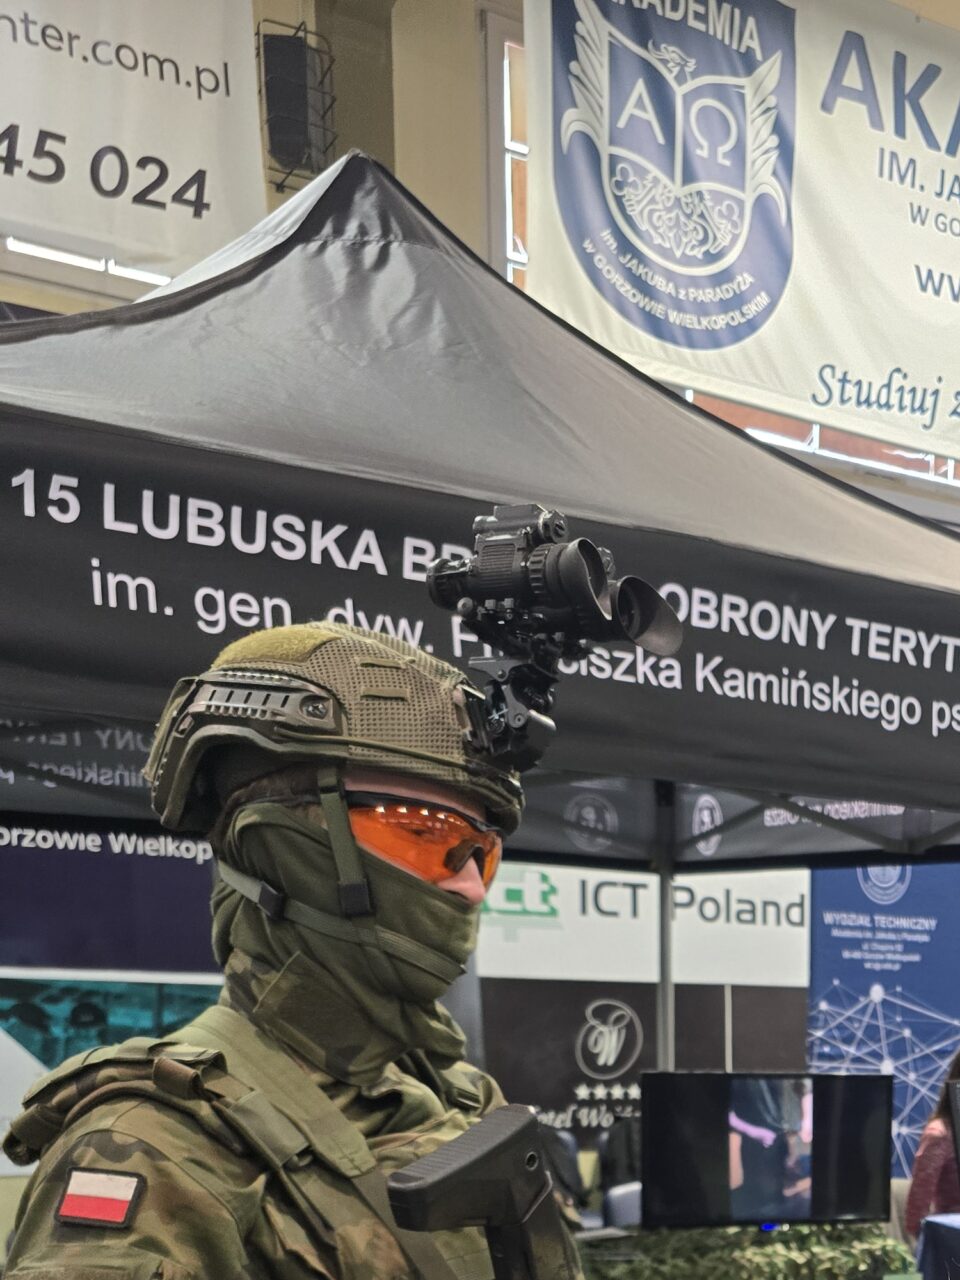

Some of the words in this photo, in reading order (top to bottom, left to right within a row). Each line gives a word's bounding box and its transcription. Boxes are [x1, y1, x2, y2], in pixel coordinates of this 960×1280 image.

[90, 145, 211, 220] 024
[877, 147, 925, 192] IM.
[908, 202, 929, 227] W
[593, 253, 666, 320] GORZOWIE
[667, 291, 772, 331] WIELKOPOLSKIM
[811, 362, 944, 430] Studiuj
[11, 468, 81, 524] 15
[103, 482, 389, 577] LUBUSKA
[658, 582, 837, 651] OBRONY
[91, 557, 174, 616] im.
[695, 652, 922, 732] Kamińskiego
[580, 879, 648, 918] ICT
[671, 885, 806, 927] Poland
